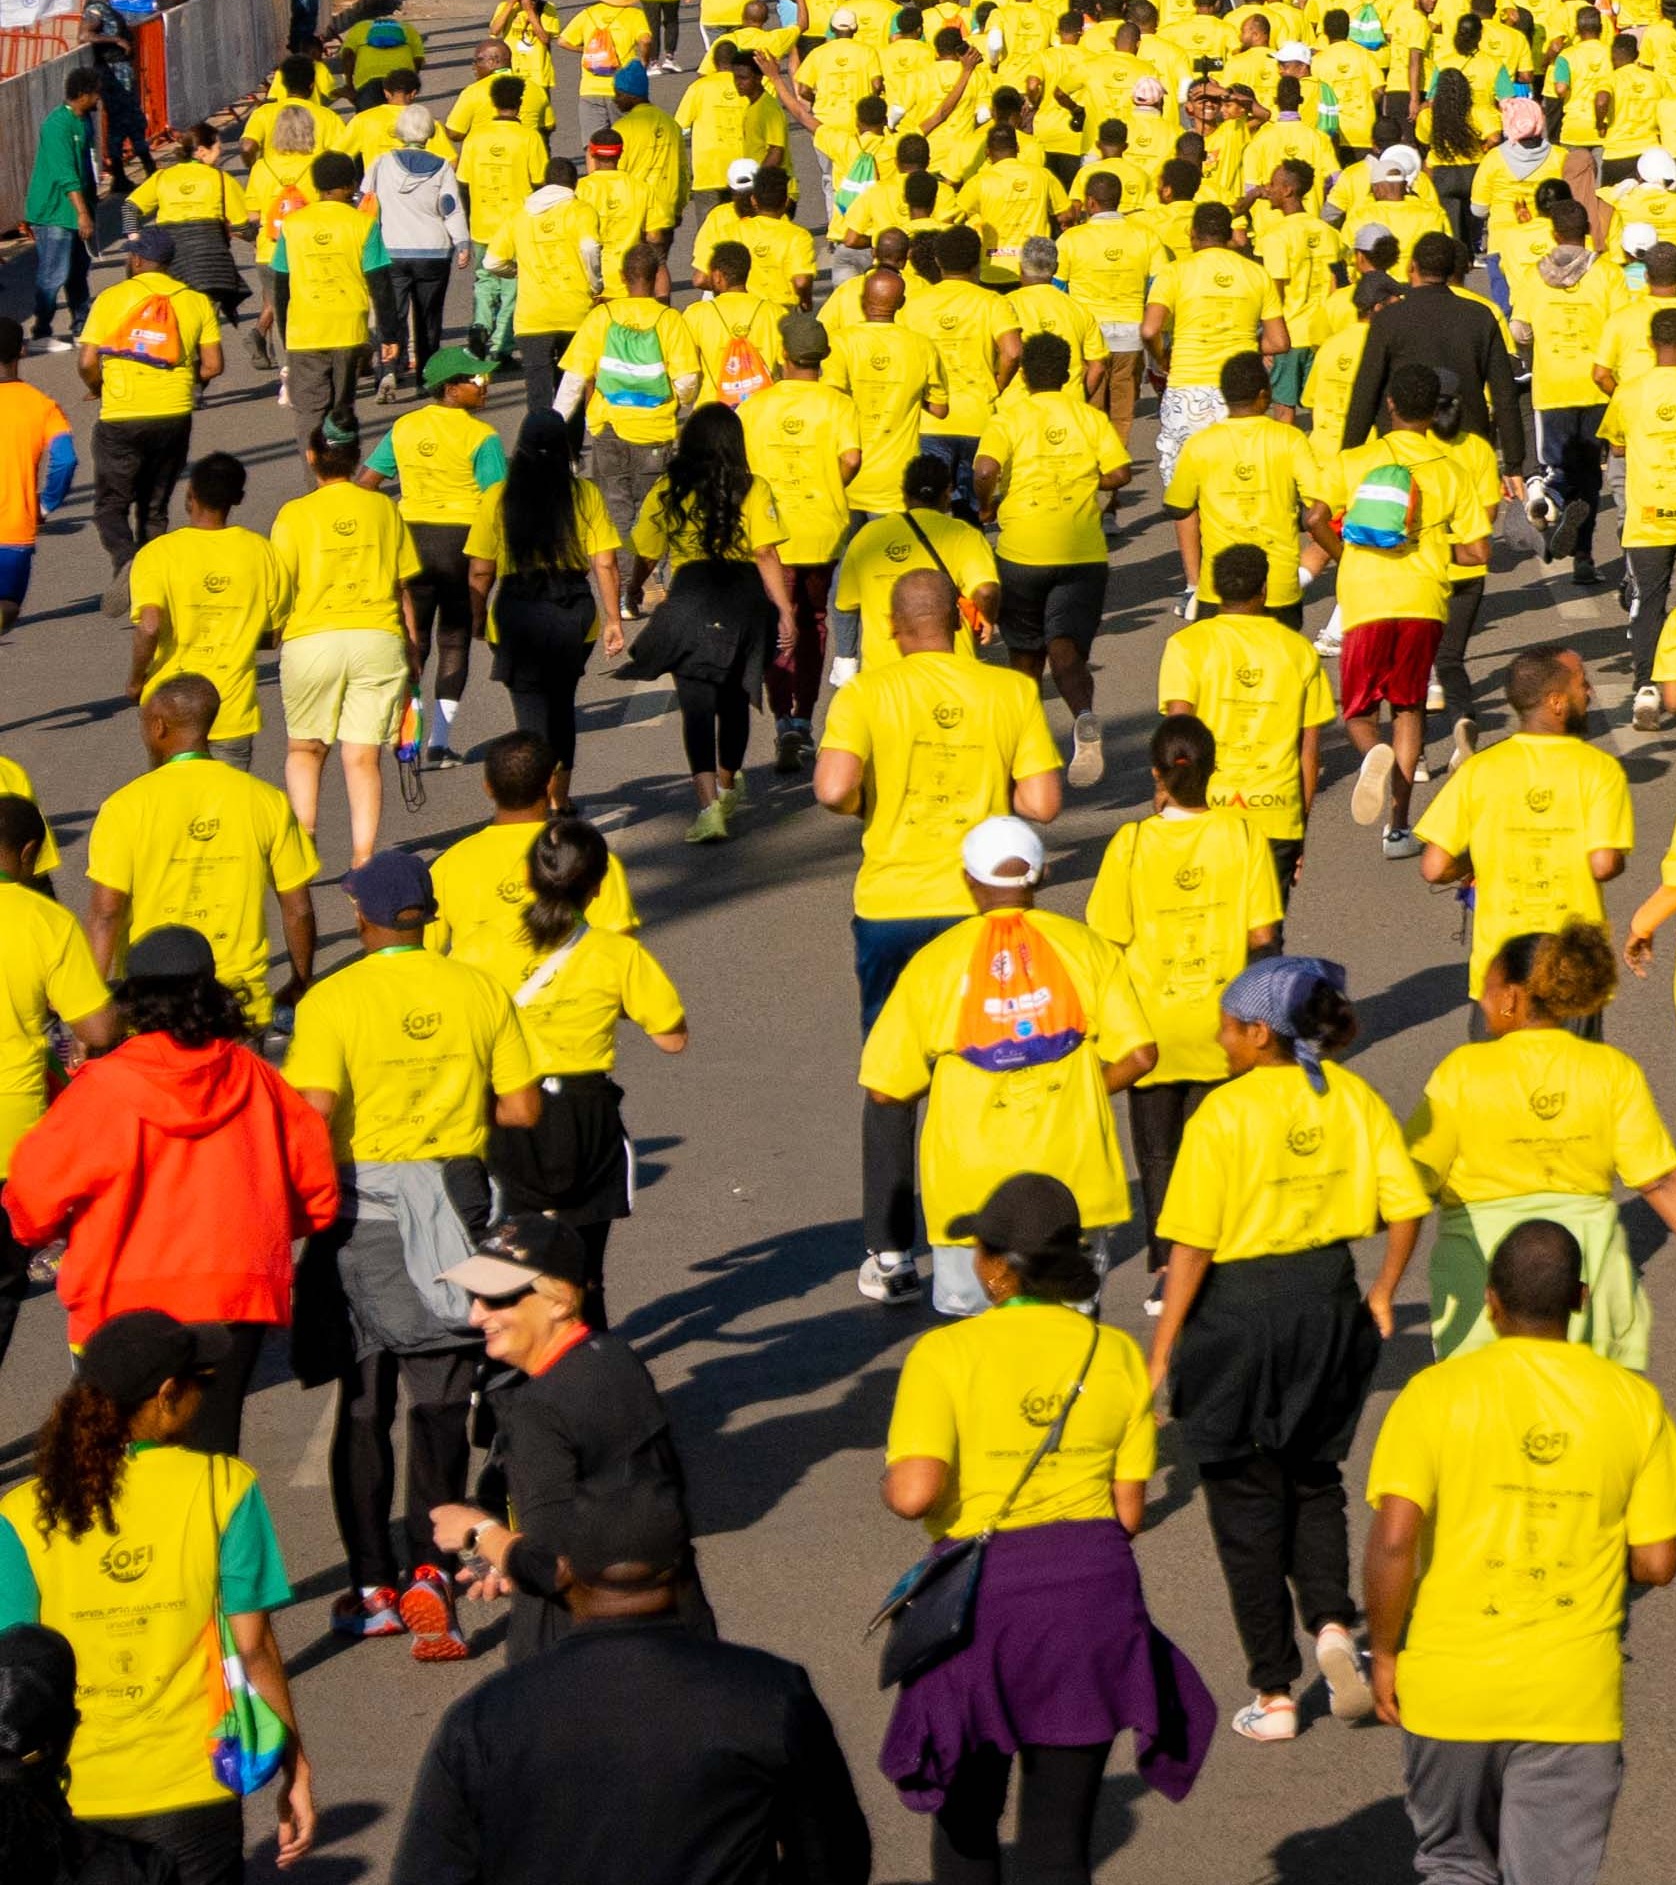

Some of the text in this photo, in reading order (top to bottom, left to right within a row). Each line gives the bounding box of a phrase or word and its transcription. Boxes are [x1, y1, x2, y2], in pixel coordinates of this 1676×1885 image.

[885, 545, 911, 558] SOFI
[202, 577, 230, 588] SOFI
[1236, 668, 1263, 680] SOFI
[932, 707, 964, 721] SOFI
[1211, 793, 1287, 810] MACON
[188, 817, 220, 835] SOFI
[1174, 867, 1204, 886] SOFI
[402, 1012, 442, 1033] SOFI
[1530, 1091, 1566, 1109] SOFI
[1286, 1129, 1325, 1147] SOFI
[1020, 1394, 1064, 1415] SOFI
[1523, 1432, 1568, 1453] SOFI
[100, 1545, 153, 1575] SOFI
[105, 1618, 136, 1630] unicef
